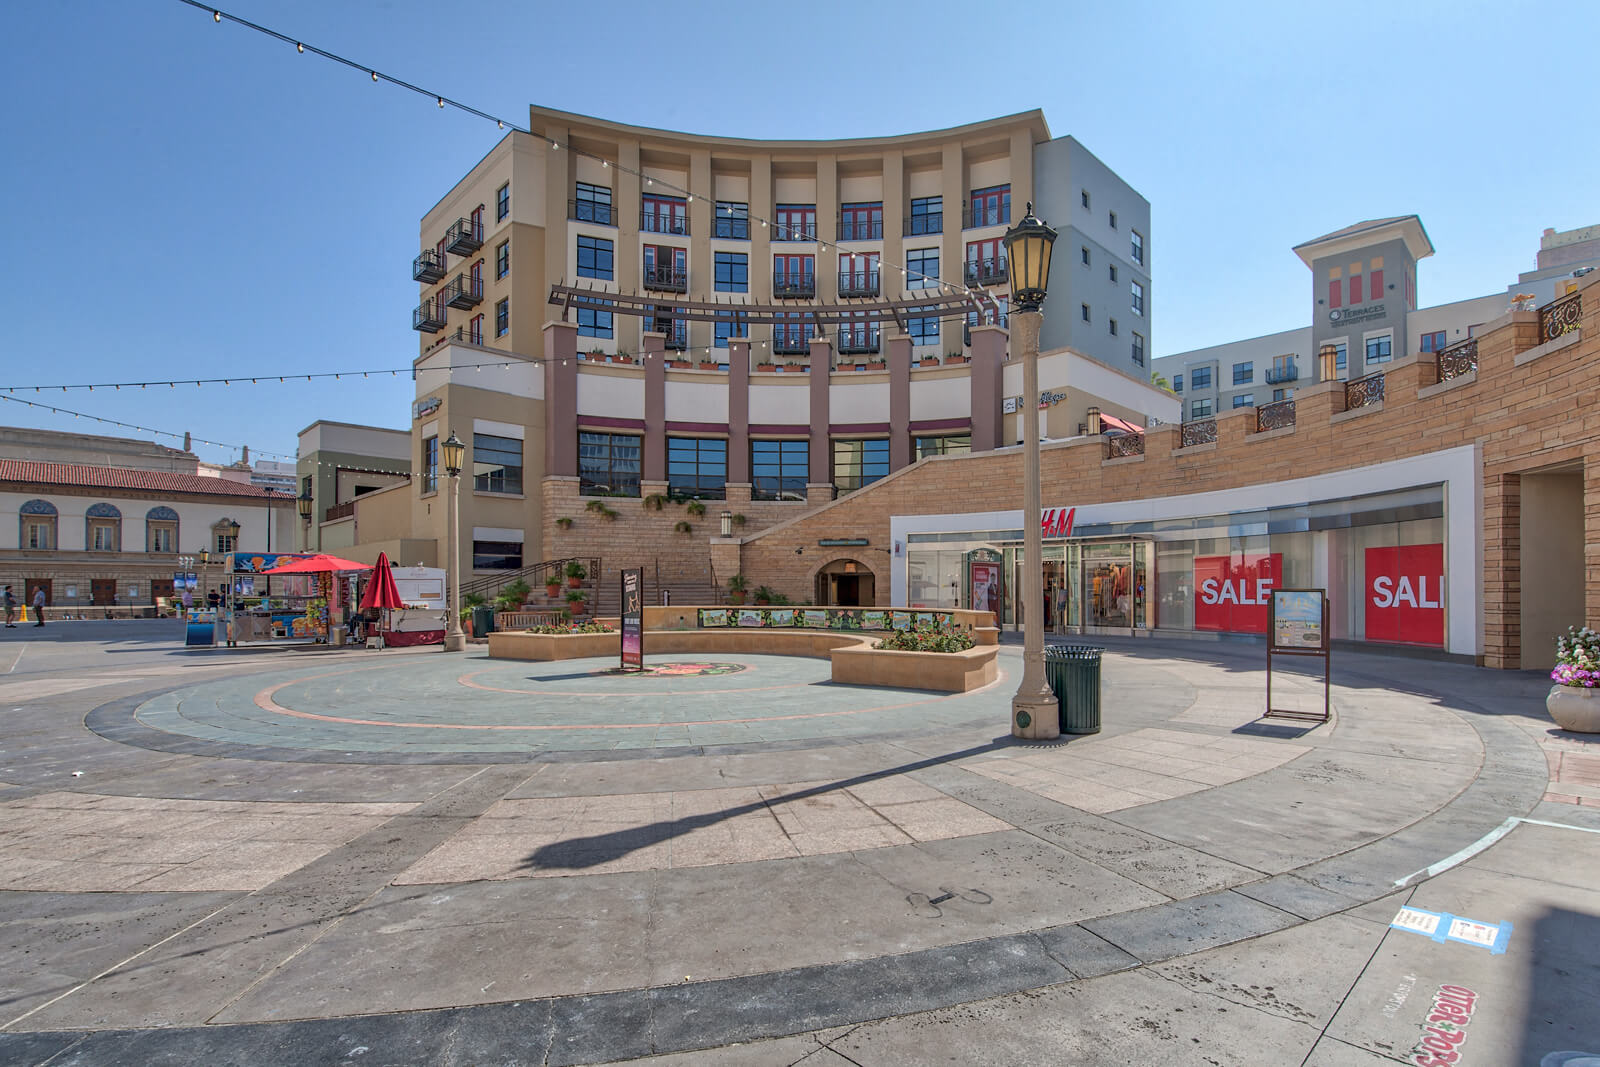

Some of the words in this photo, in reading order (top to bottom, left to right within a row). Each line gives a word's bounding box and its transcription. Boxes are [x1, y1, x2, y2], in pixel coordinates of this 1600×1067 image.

[1342, 304, 1384, 319] TERRACES
[1041, 508, 1076, 538] H&M
[1201, 578, 1273, 605] SALE
[1373, 575, 1444, 608] SAL
